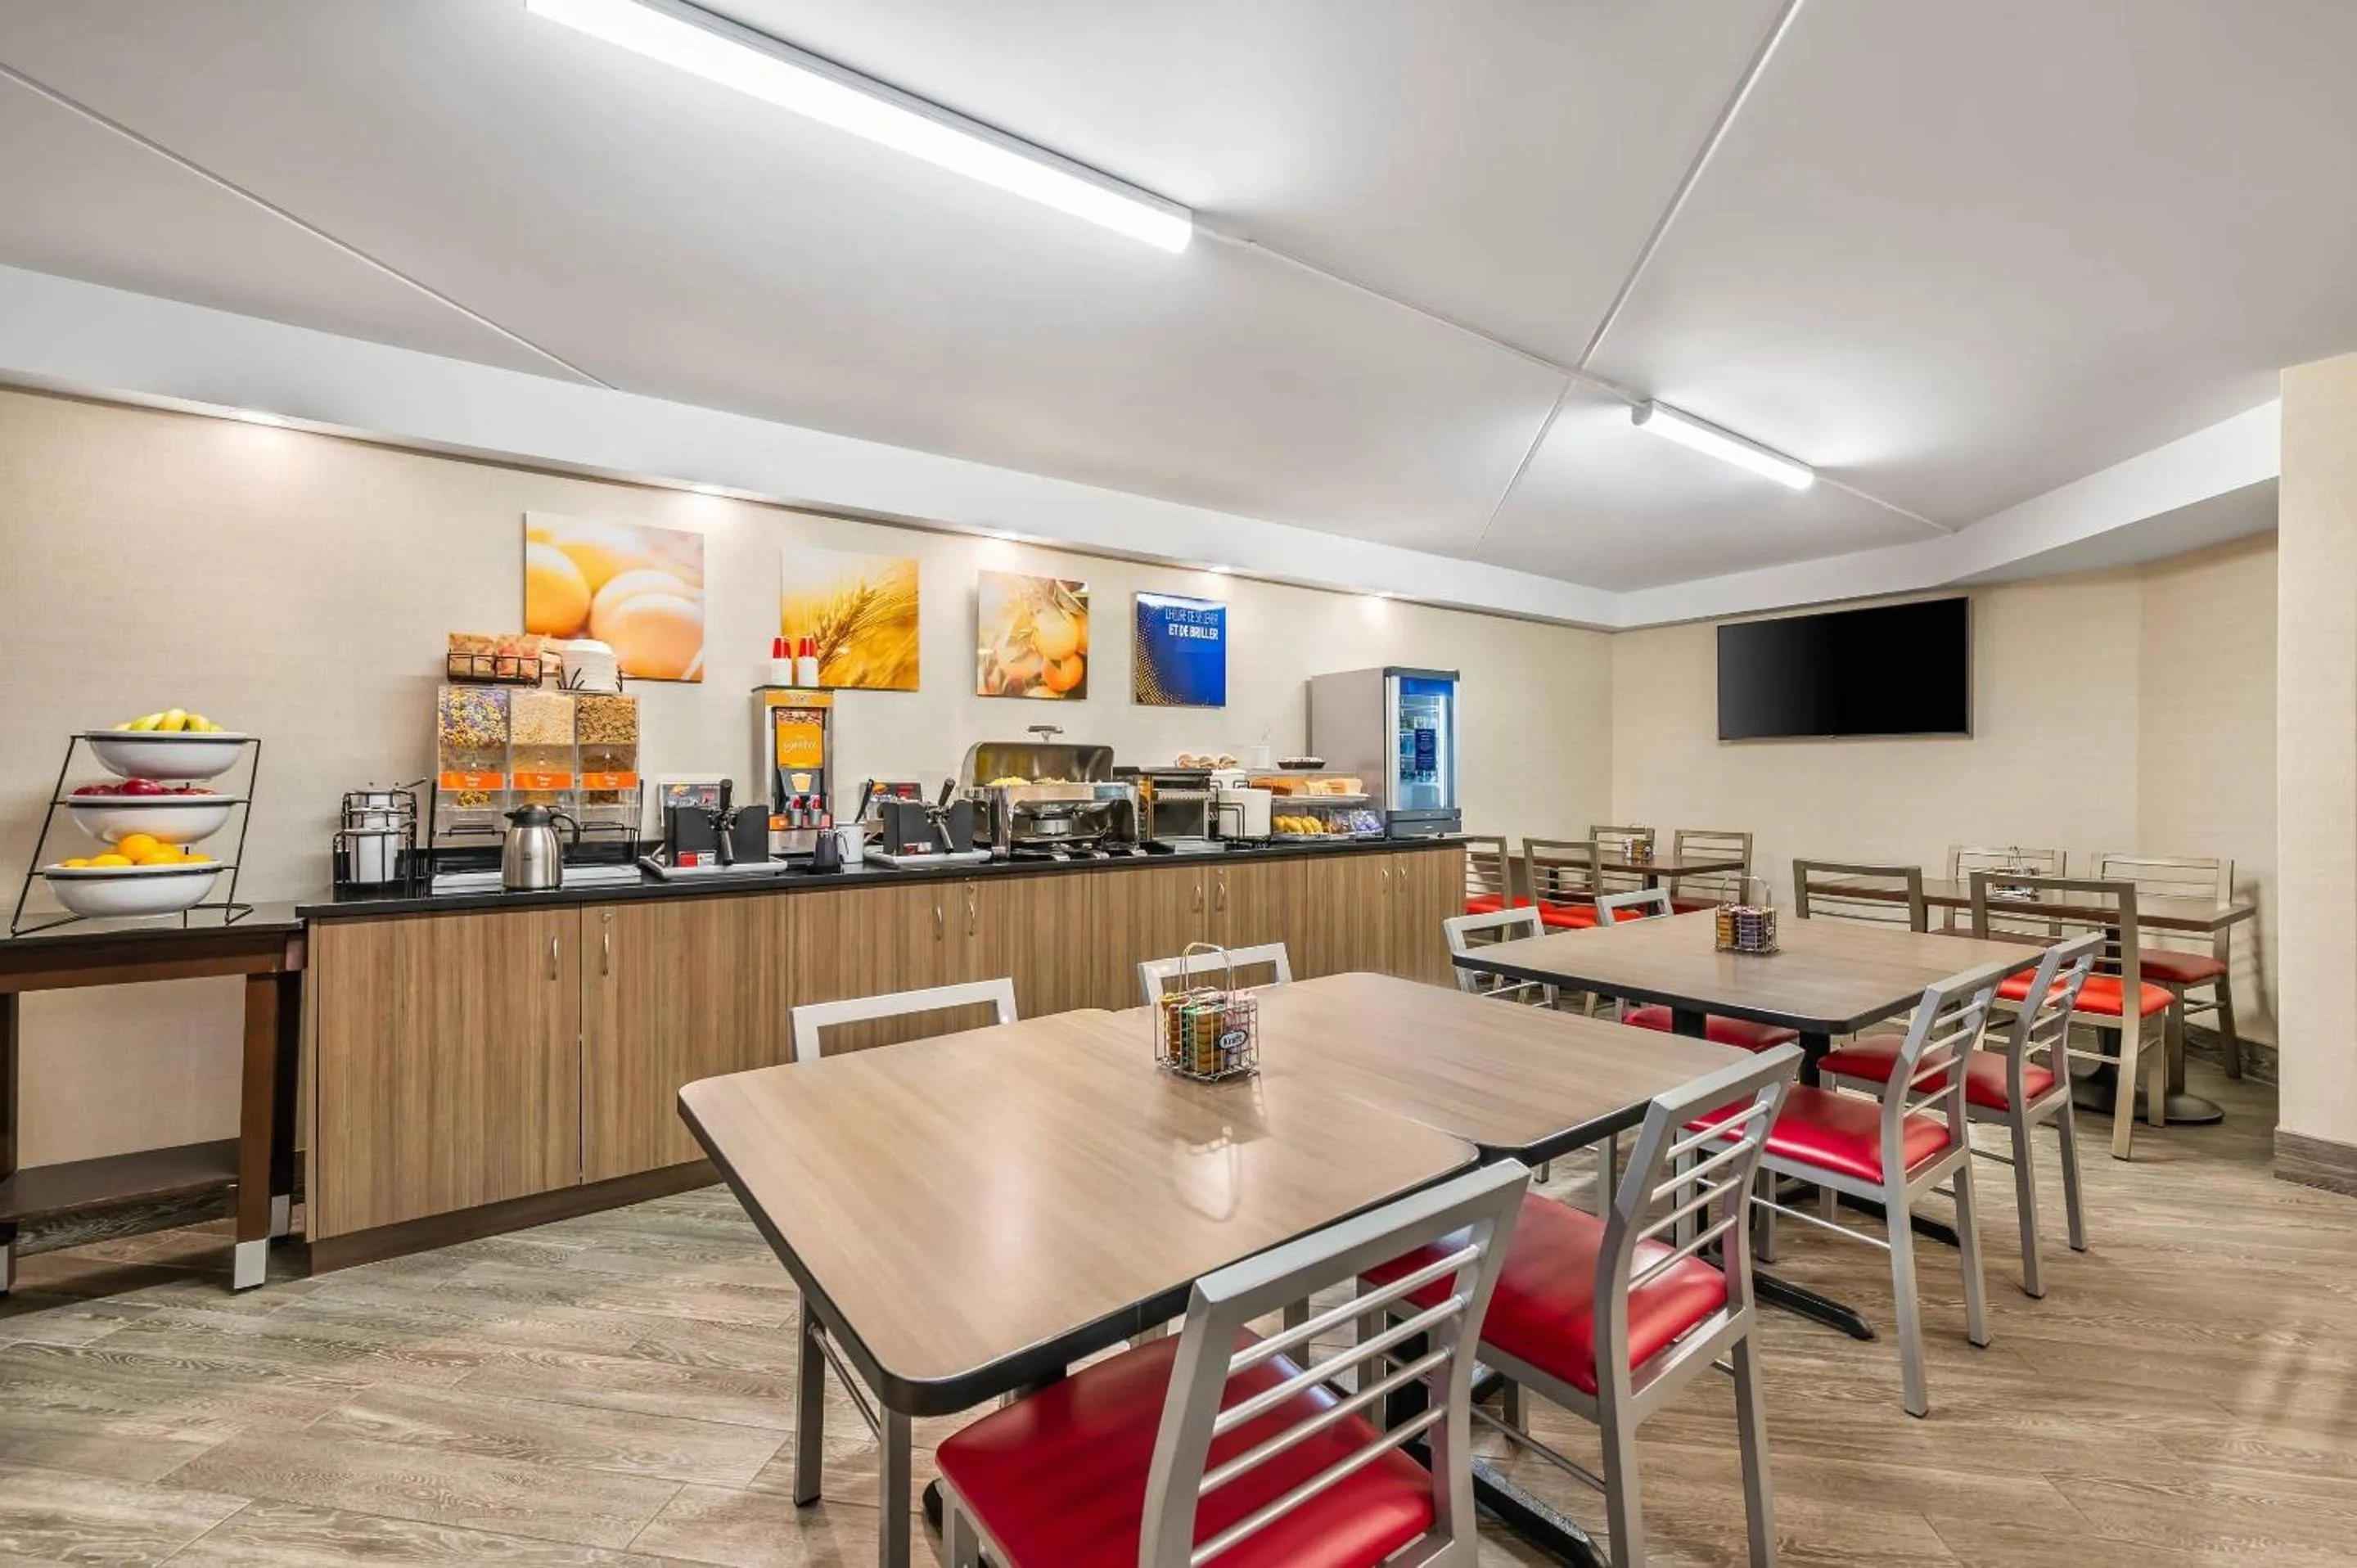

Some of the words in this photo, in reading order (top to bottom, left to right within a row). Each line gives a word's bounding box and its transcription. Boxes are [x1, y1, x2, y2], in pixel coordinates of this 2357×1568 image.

[1169, 623, 1178, 636] ET
[1179, 624, 1188, 638] DE
[1189, 625, 1219, 641] BRILLER
